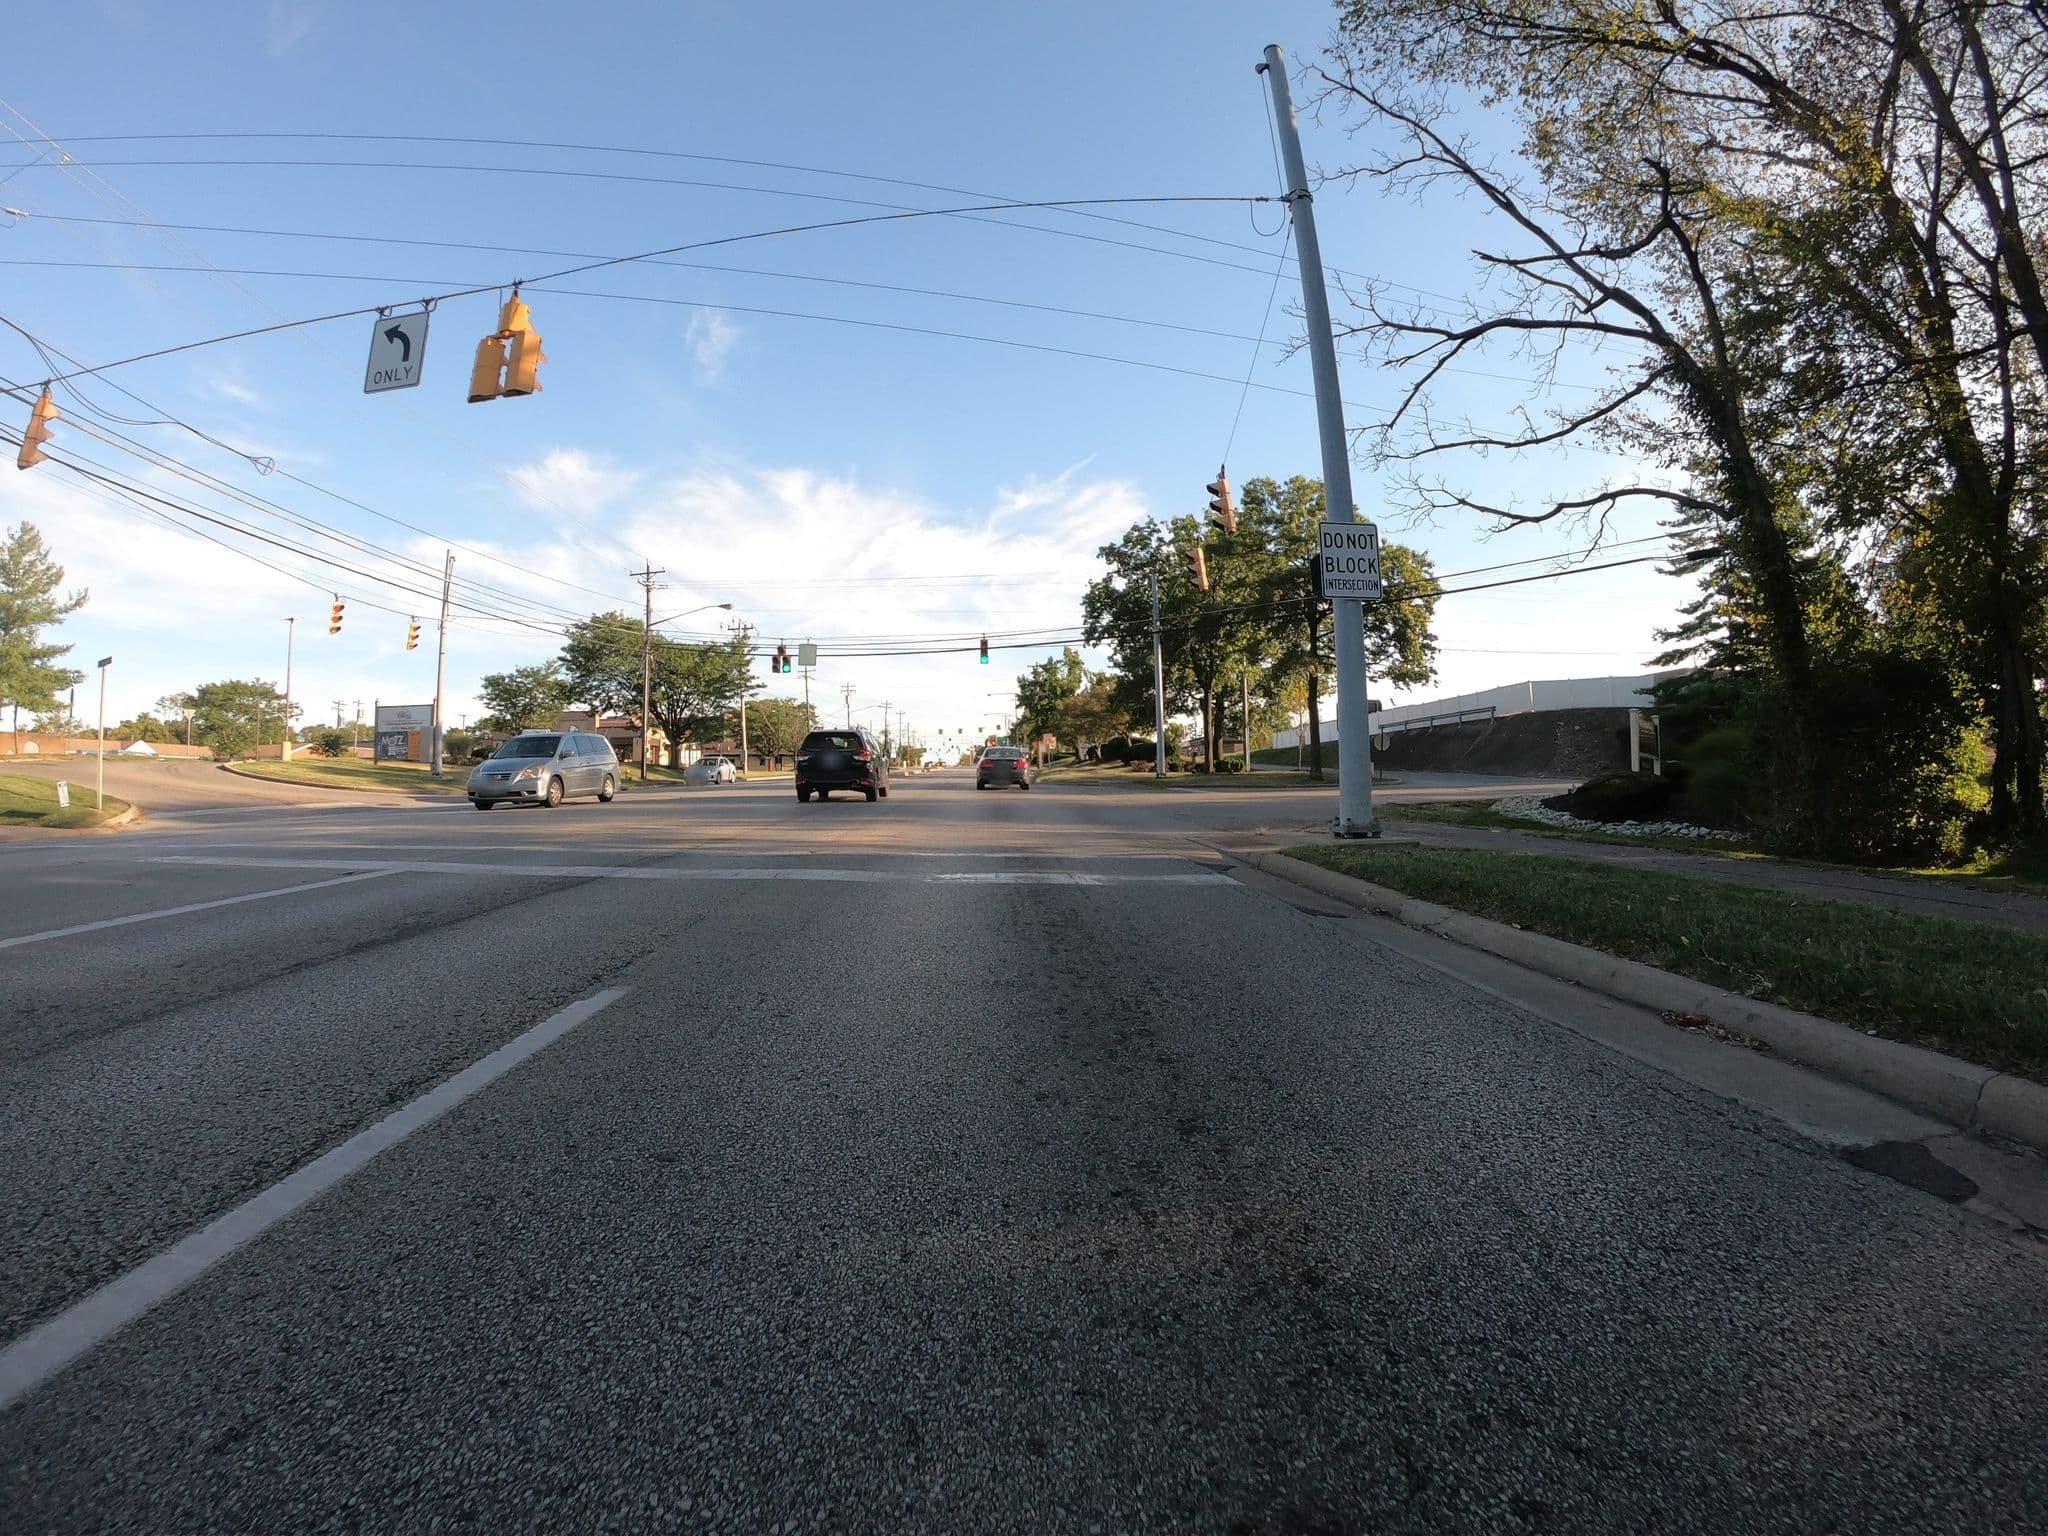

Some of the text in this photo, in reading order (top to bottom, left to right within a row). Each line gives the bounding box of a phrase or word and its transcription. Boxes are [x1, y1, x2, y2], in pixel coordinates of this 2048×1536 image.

[373, 366, 413, 384] ONLY
[1323, 532, 1375, 550] DO NOT
[1325, 556, 1378, 574] BLOCK
[1325, 577, 1379, 591] INTERSECTION
